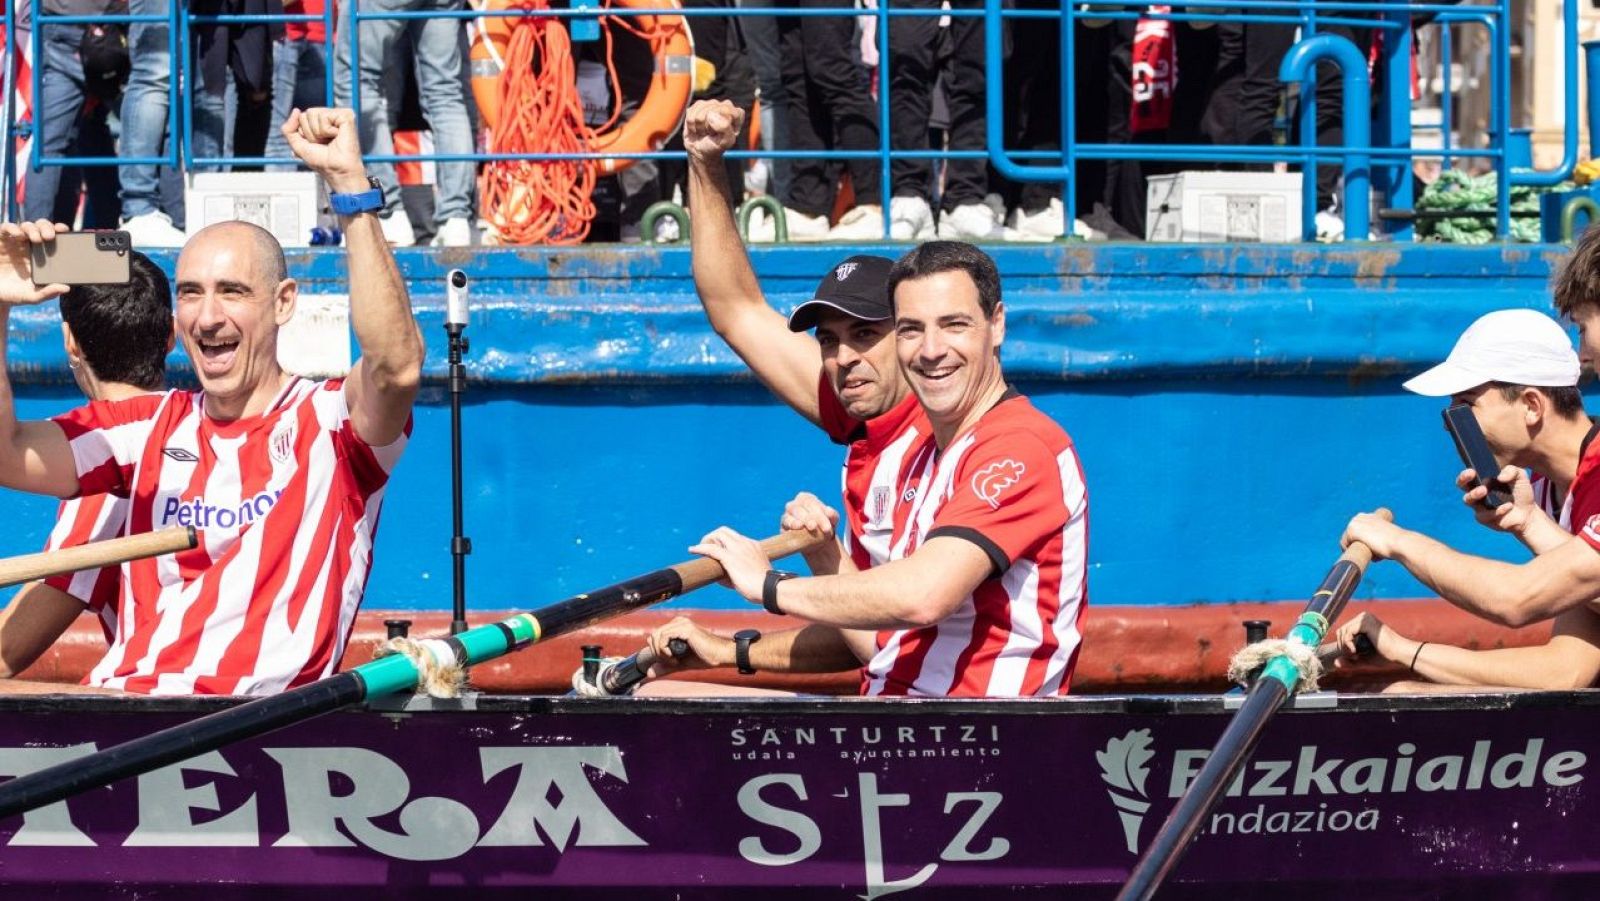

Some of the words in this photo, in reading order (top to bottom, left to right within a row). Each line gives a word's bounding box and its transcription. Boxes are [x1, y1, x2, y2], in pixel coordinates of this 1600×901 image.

[162, 490, 286, 528] Petrono
[731, 726, 999, 745] SANTURTZI
[733, 750, 796, 760] udala
[840, 747, 1001, 760] ayuntamiento
[1204, 804, 1380, 835] ndazioa
